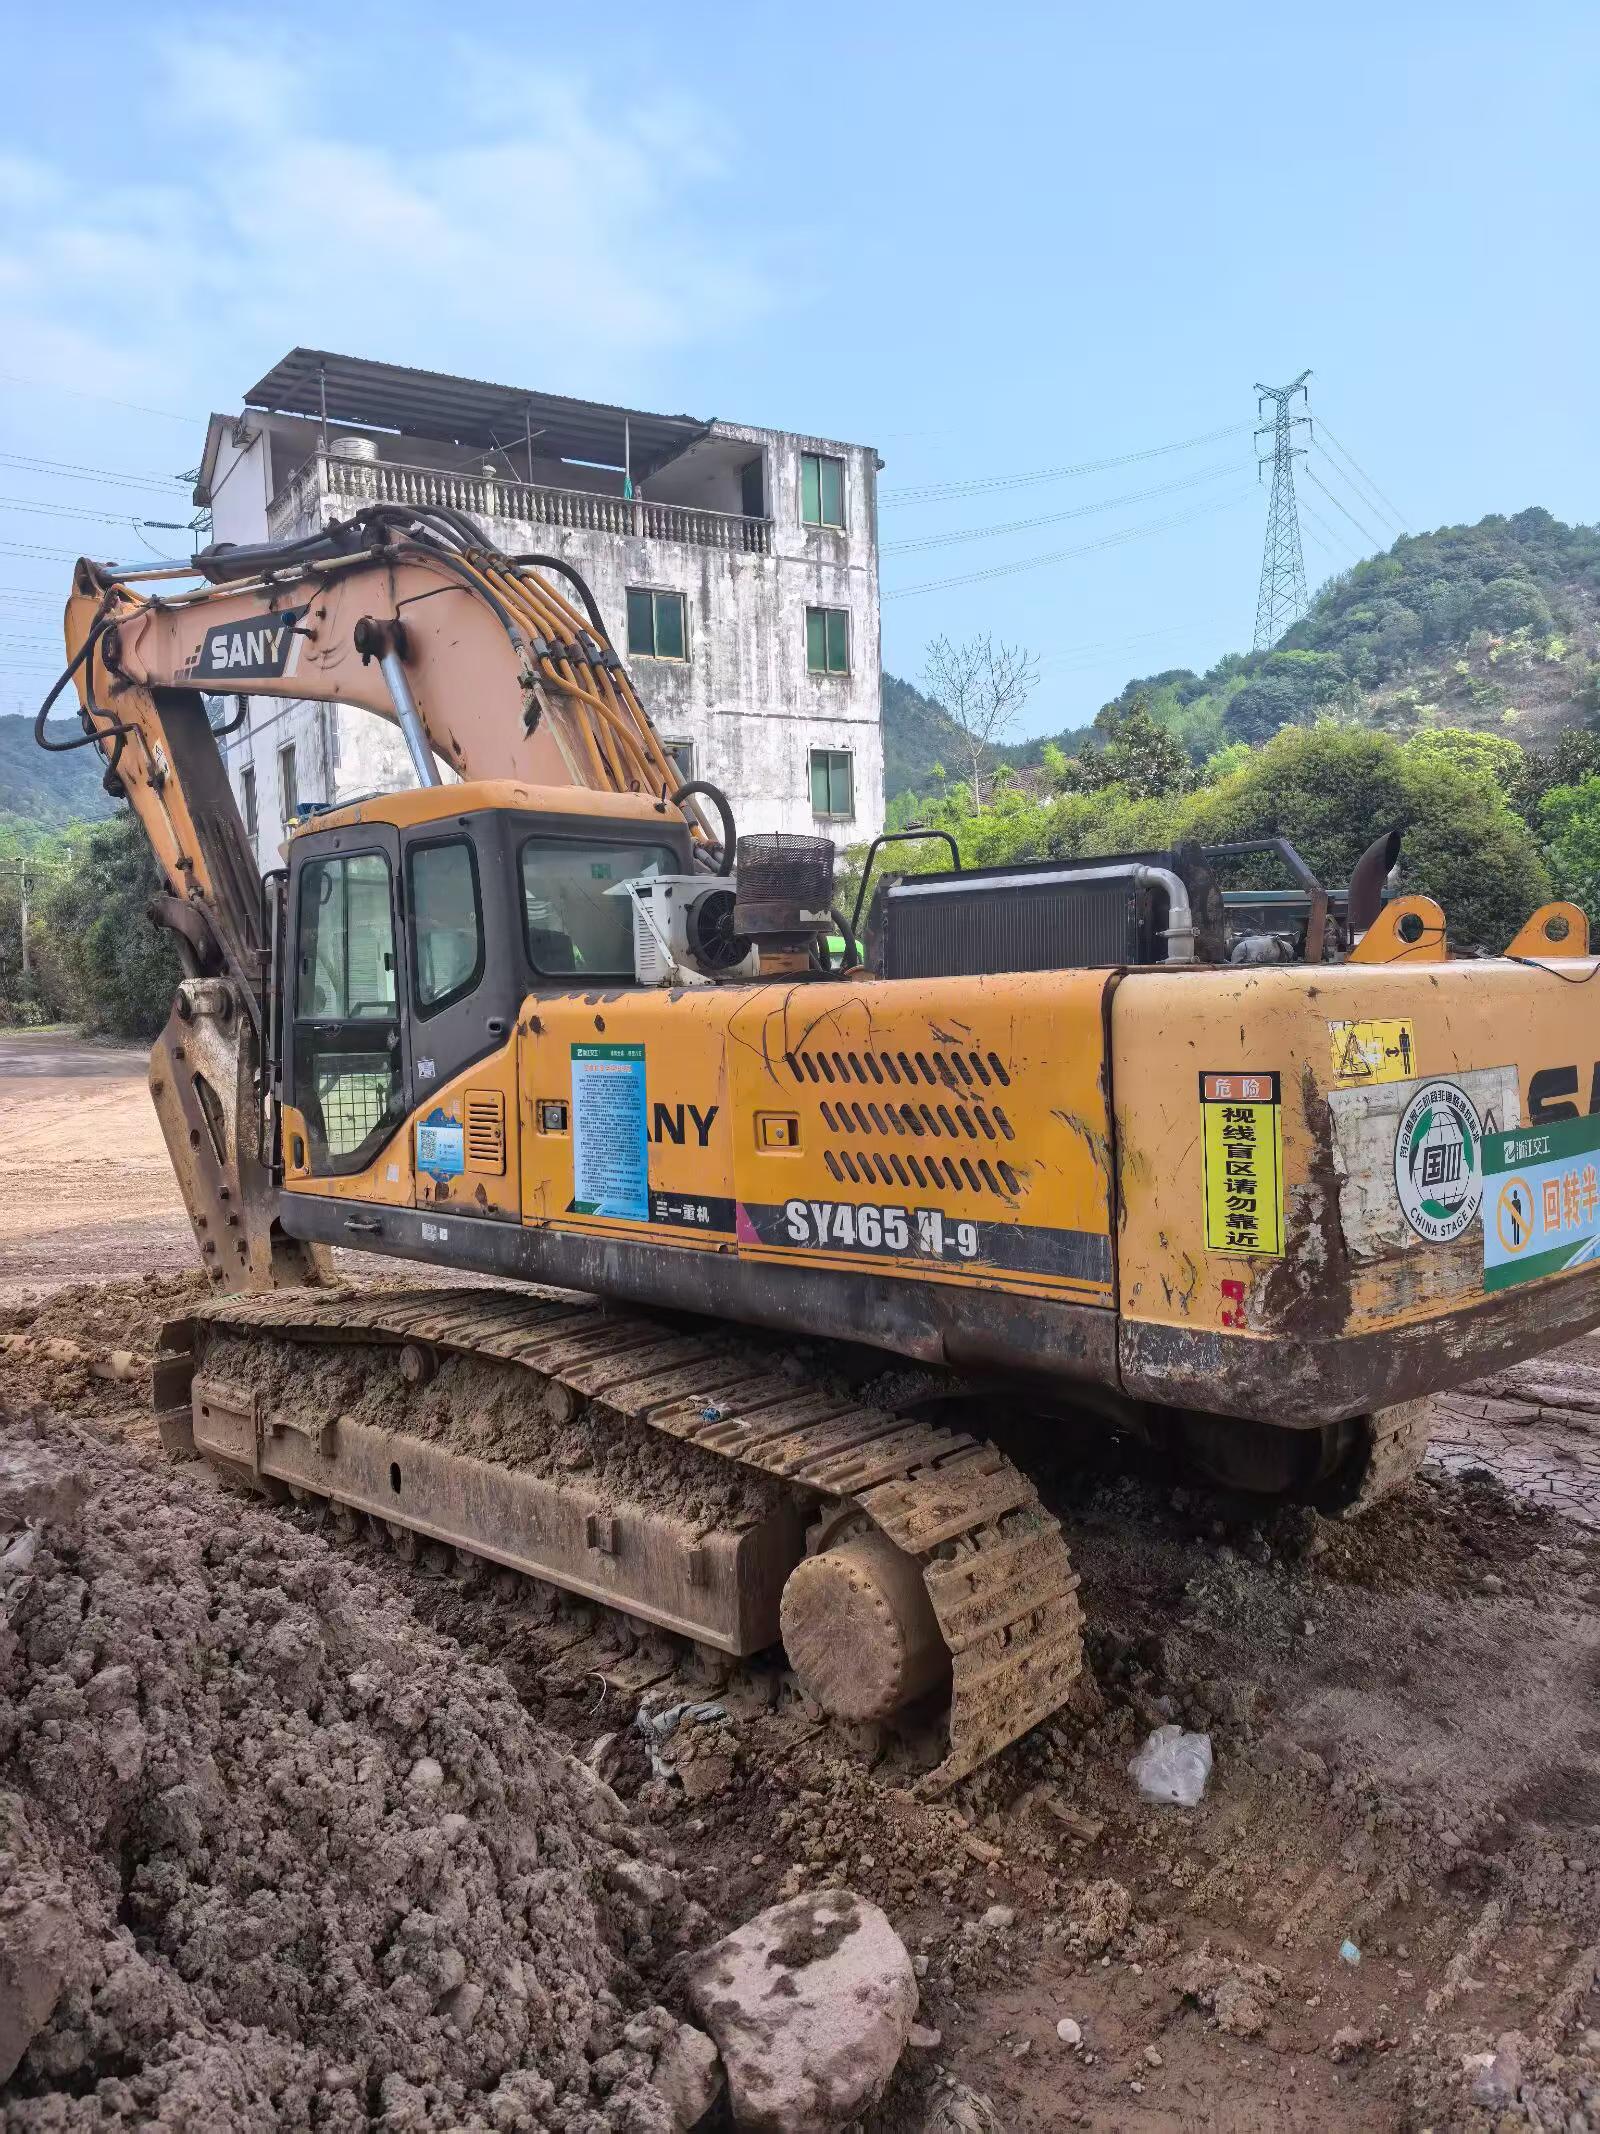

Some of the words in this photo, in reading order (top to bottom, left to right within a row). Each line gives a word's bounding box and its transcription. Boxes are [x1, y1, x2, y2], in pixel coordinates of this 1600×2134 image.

[211, 627, 285, 670] SANY
[1215, 1078, 1260, 1099] 危险
[1515, 1135, 1551, 1161] 浙江交工
[1221, 1107, 1260, 1248] 视线盲区请勿靠近
[655, 1200, 710, 1223] 三一重机
[1410, 1207, 1438, 1237] CHINA
[1441, 1210, 1469, 1237] STAGE
